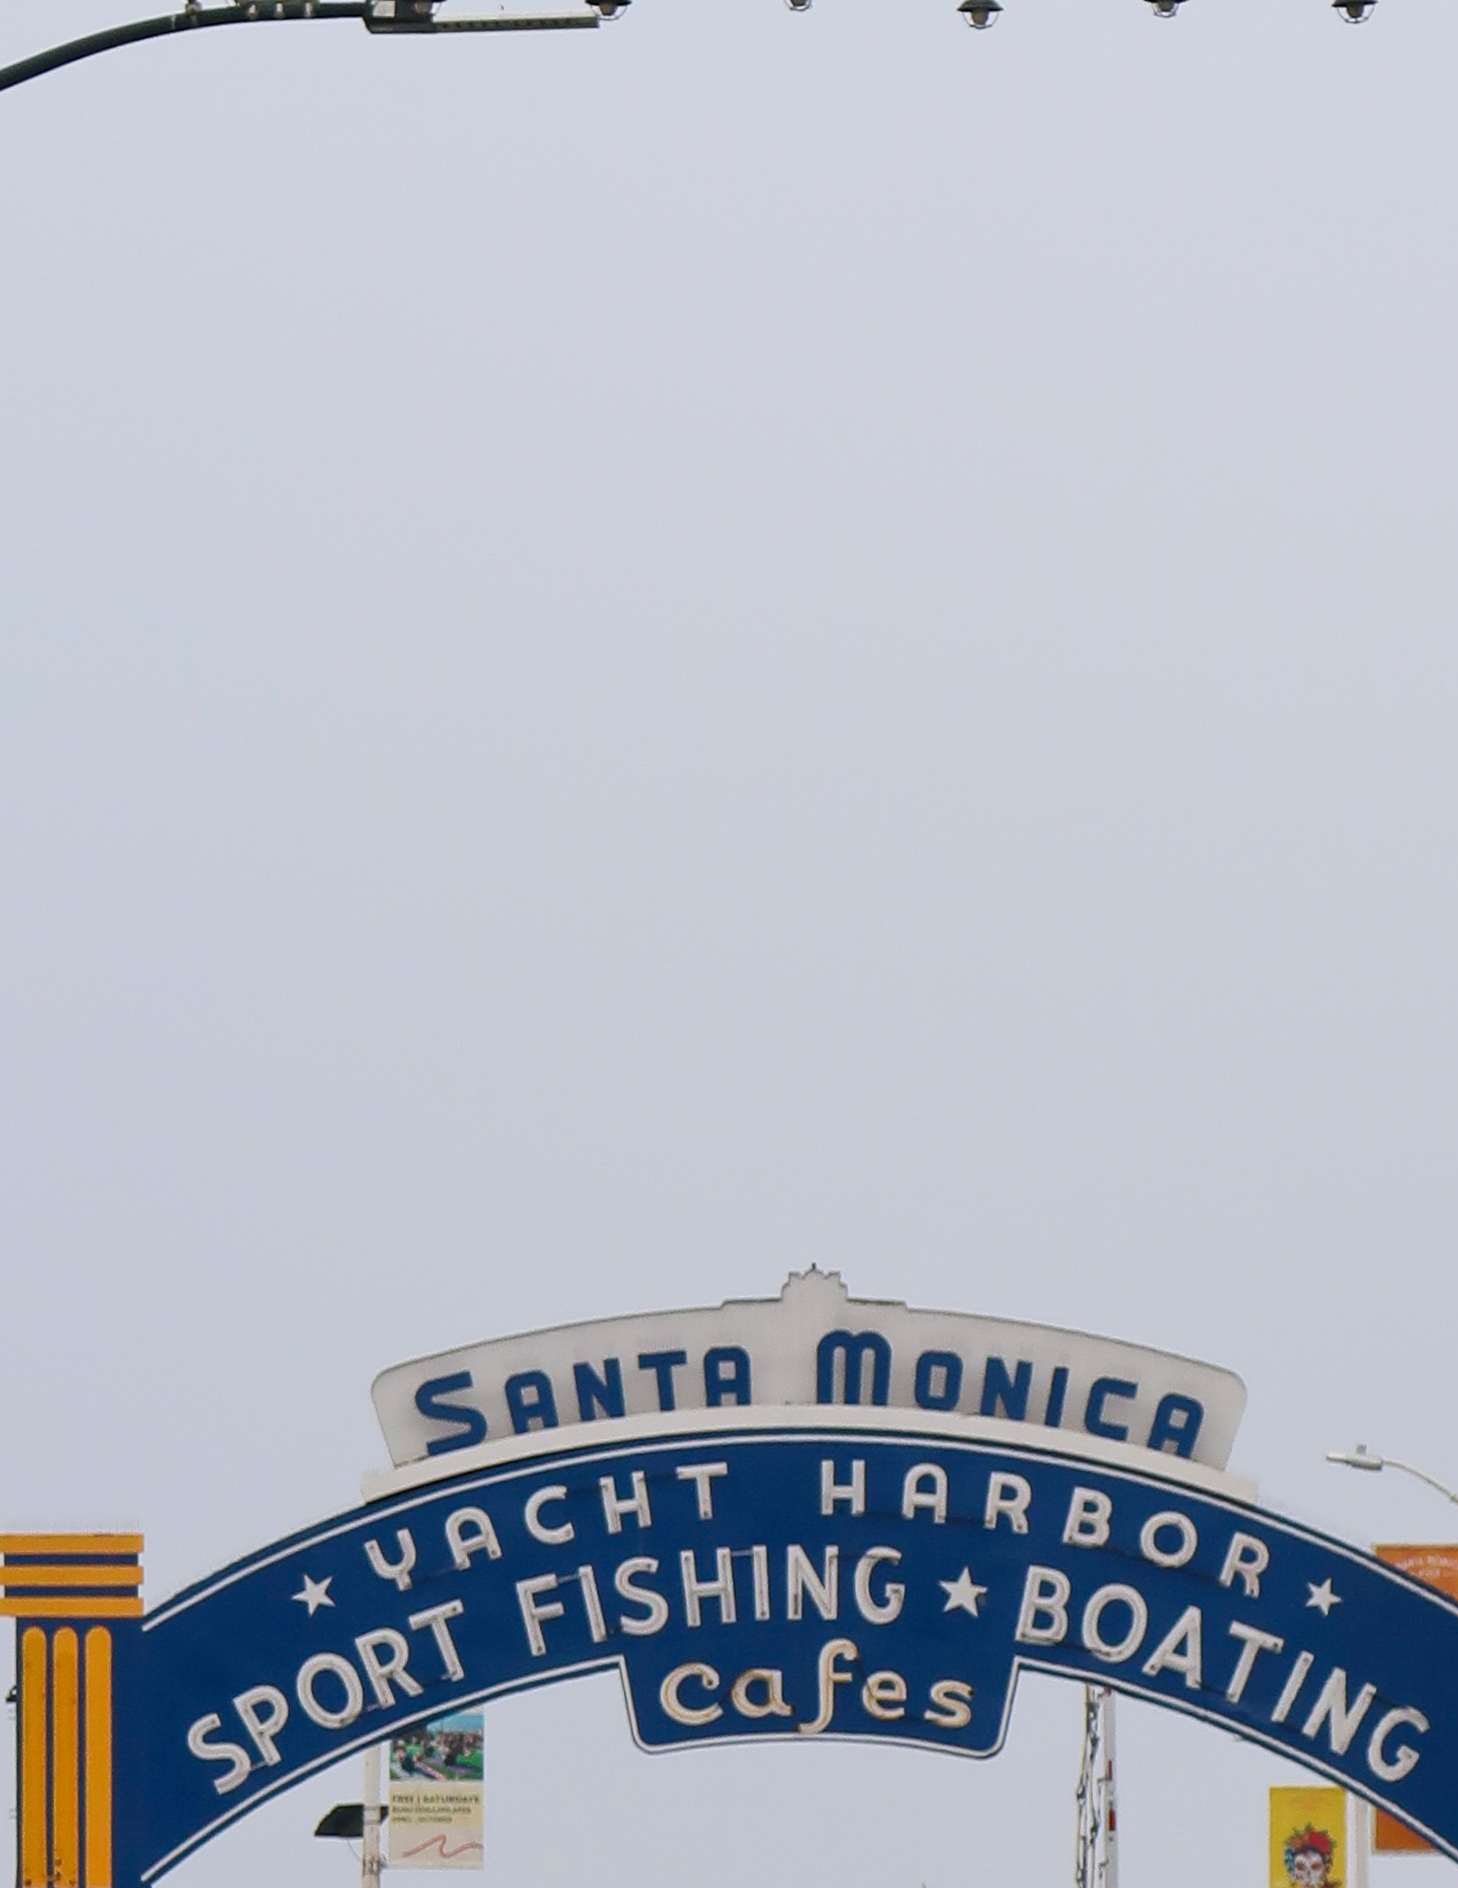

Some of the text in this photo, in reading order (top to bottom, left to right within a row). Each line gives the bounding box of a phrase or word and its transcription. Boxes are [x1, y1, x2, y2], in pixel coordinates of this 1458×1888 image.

[413, 1329, 1206, 1459] SANTA MONICA
[363, 1458, 1271, 1597] YACHT HARBOR
[186, 1544, 1431, 1796] SPORT FISHING BOATING
